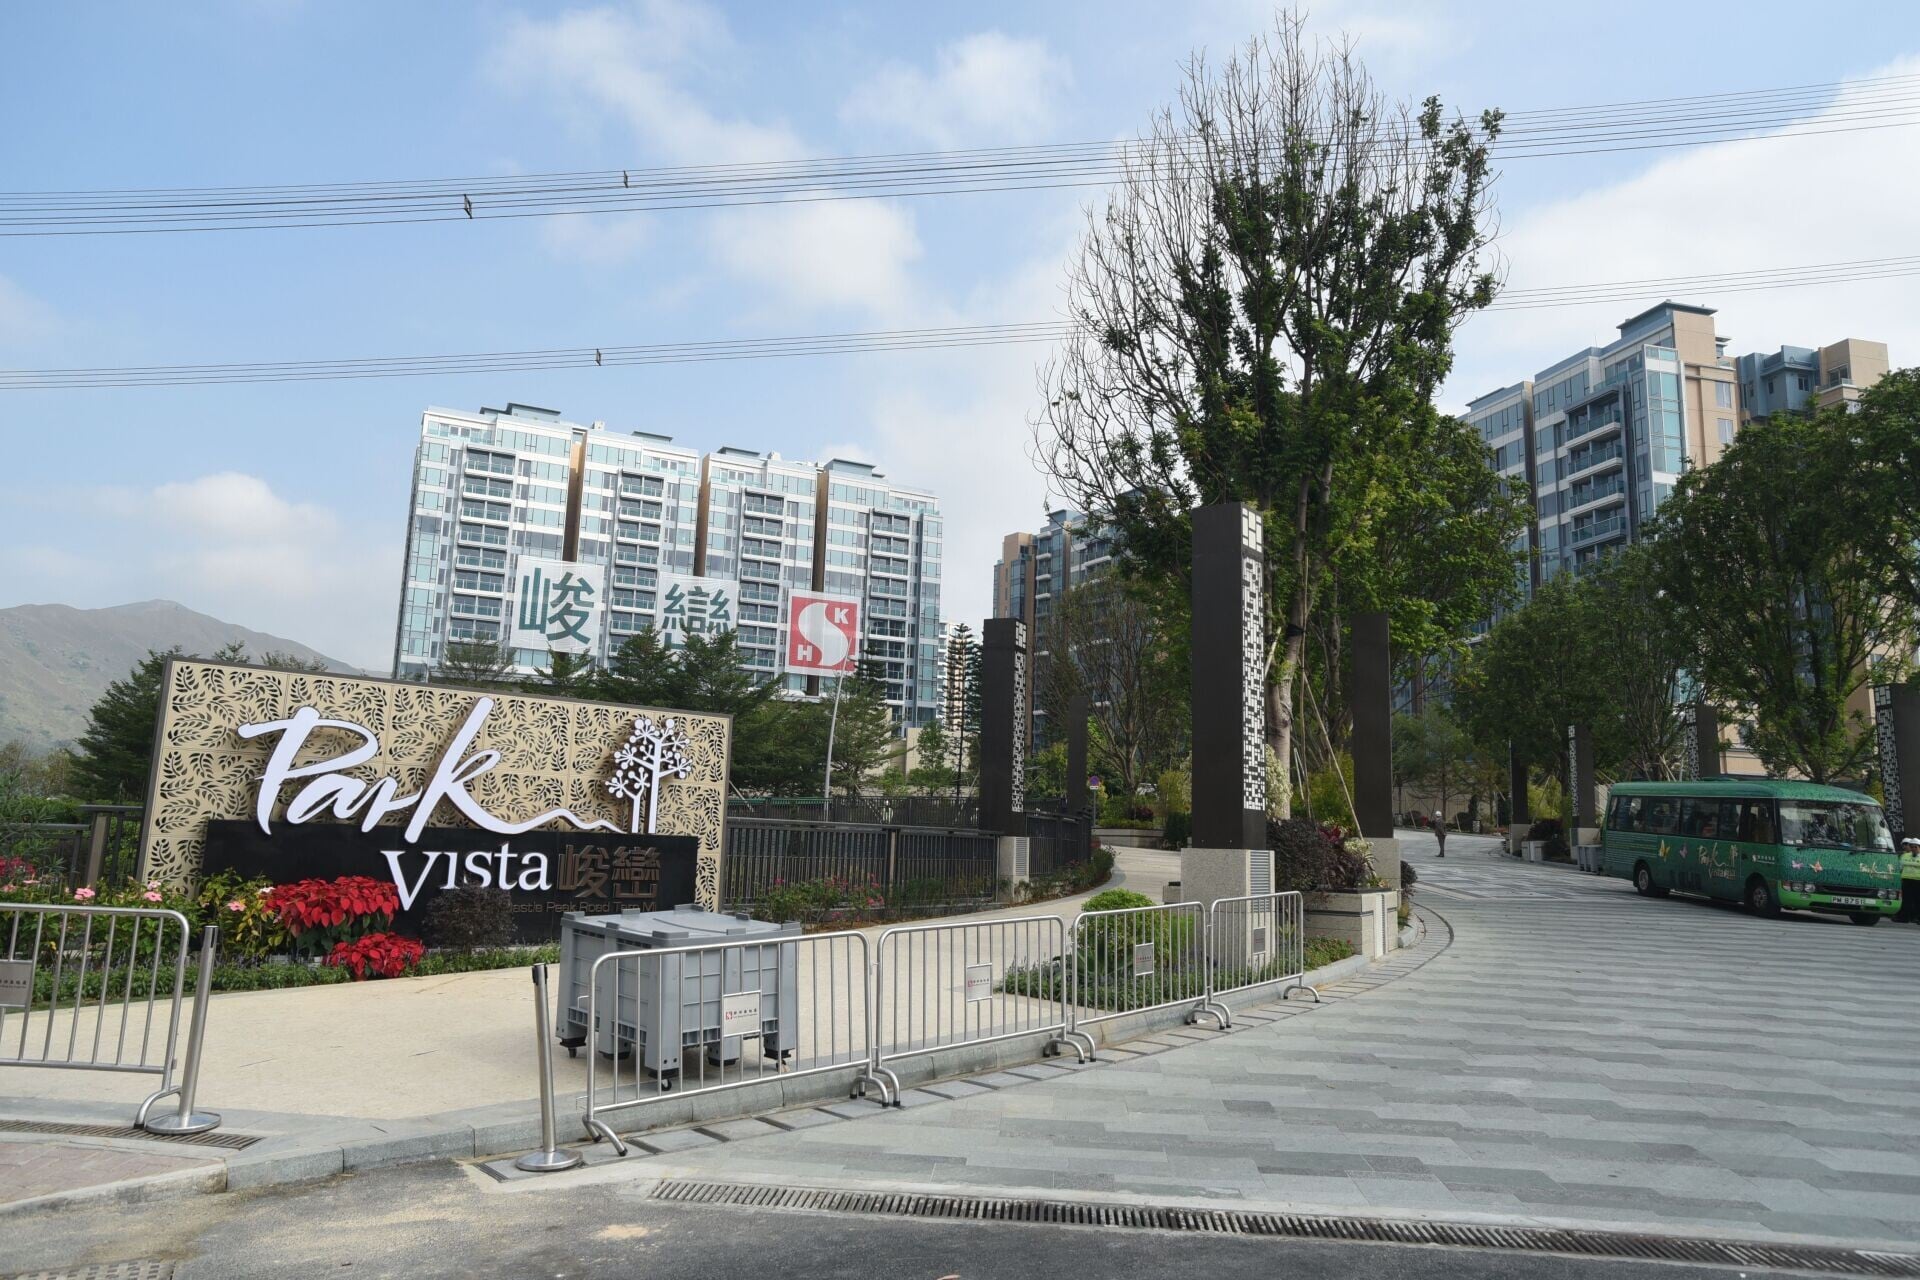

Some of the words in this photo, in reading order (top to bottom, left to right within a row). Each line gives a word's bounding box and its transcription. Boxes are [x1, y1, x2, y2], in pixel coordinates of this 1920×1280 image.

[238, 697, 627, 842] Park
[380, 842, 552, 911] Vista
[557, 844, 661, 899] 峻巒
[511, 901, 543, 913] astle
[546, 902, 576, 912] Peak
[579, 902, 609, 913] Road
